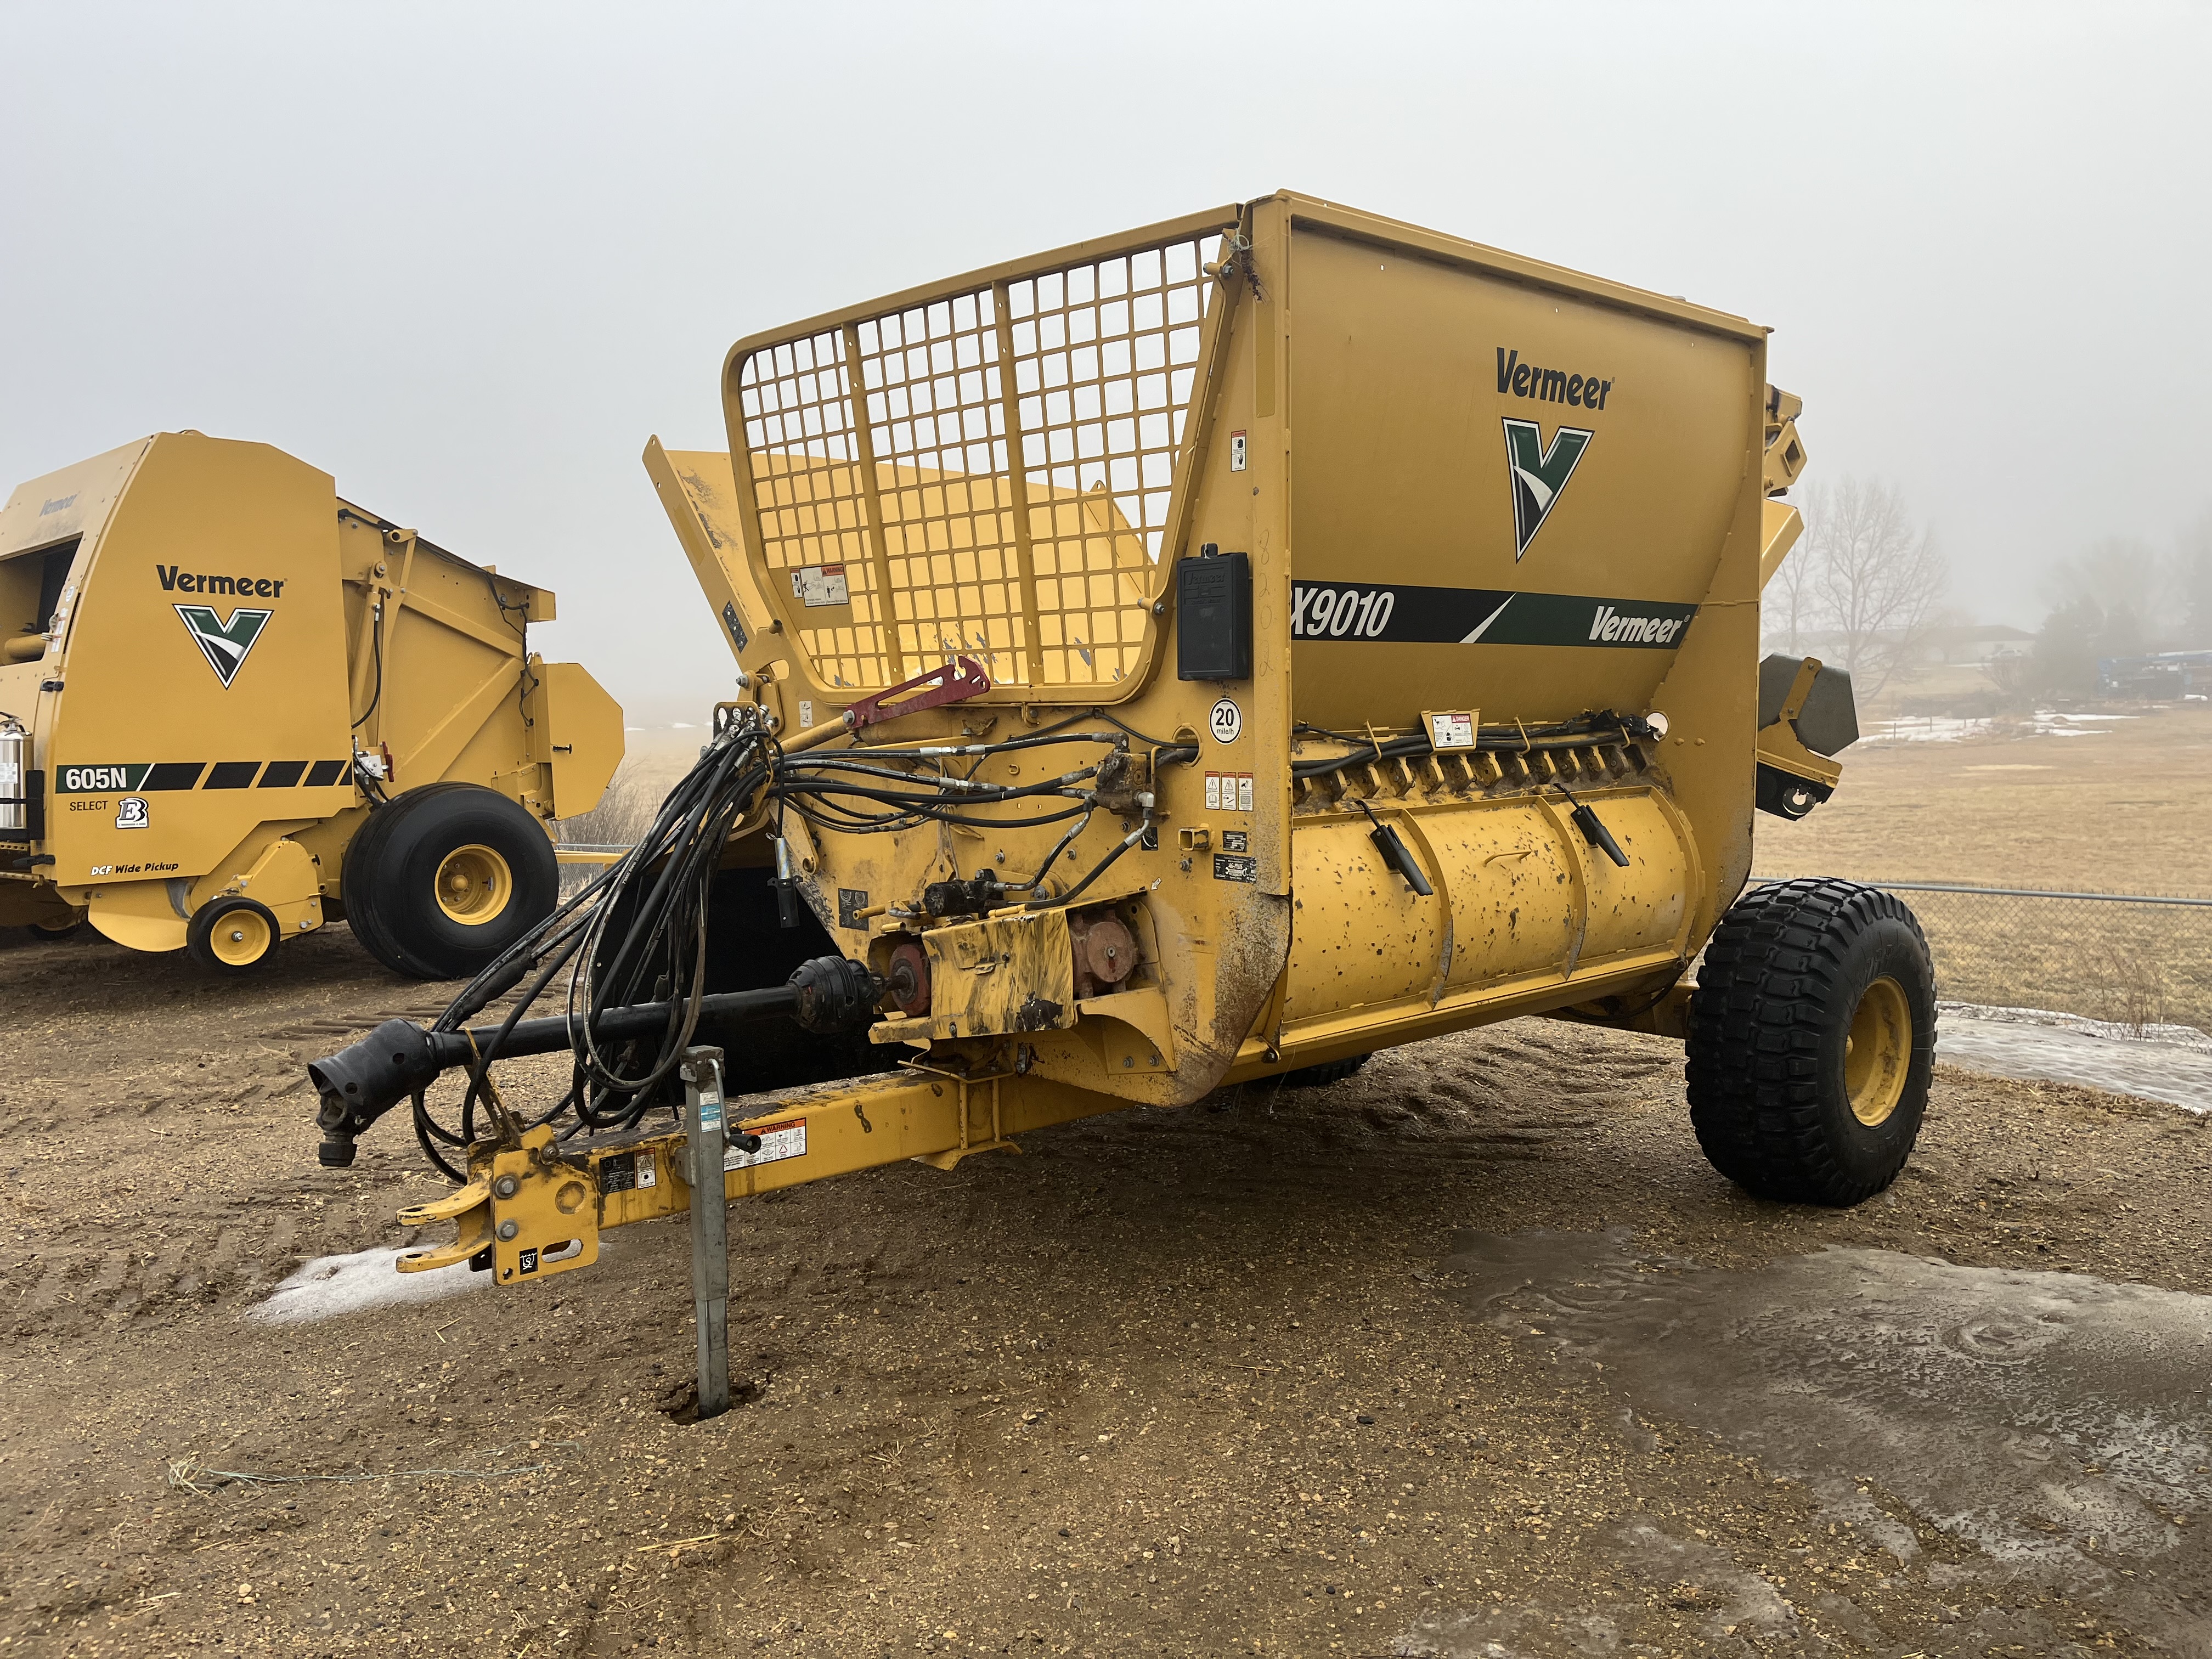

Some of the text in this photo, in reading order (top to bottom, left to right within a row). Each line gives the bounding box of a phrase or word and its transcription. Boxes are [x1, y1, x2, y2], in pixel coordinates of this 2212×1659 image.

[1497, 347, 1611, 410] Vermeer
[156, 565, 284, 598] Vermeer
[1291, 587, 1395, 637] X9010
[1588, 606, 1683, 644] Vermeer
[1215, 708, 1234, 726] 20
[66, 768, 127, 790] 605N
[70, 800, 109, 811] SELECT
[91, 862, 179, 876] DCF Wide Pickup
[767, 1121, 795, 1132] WARNING
